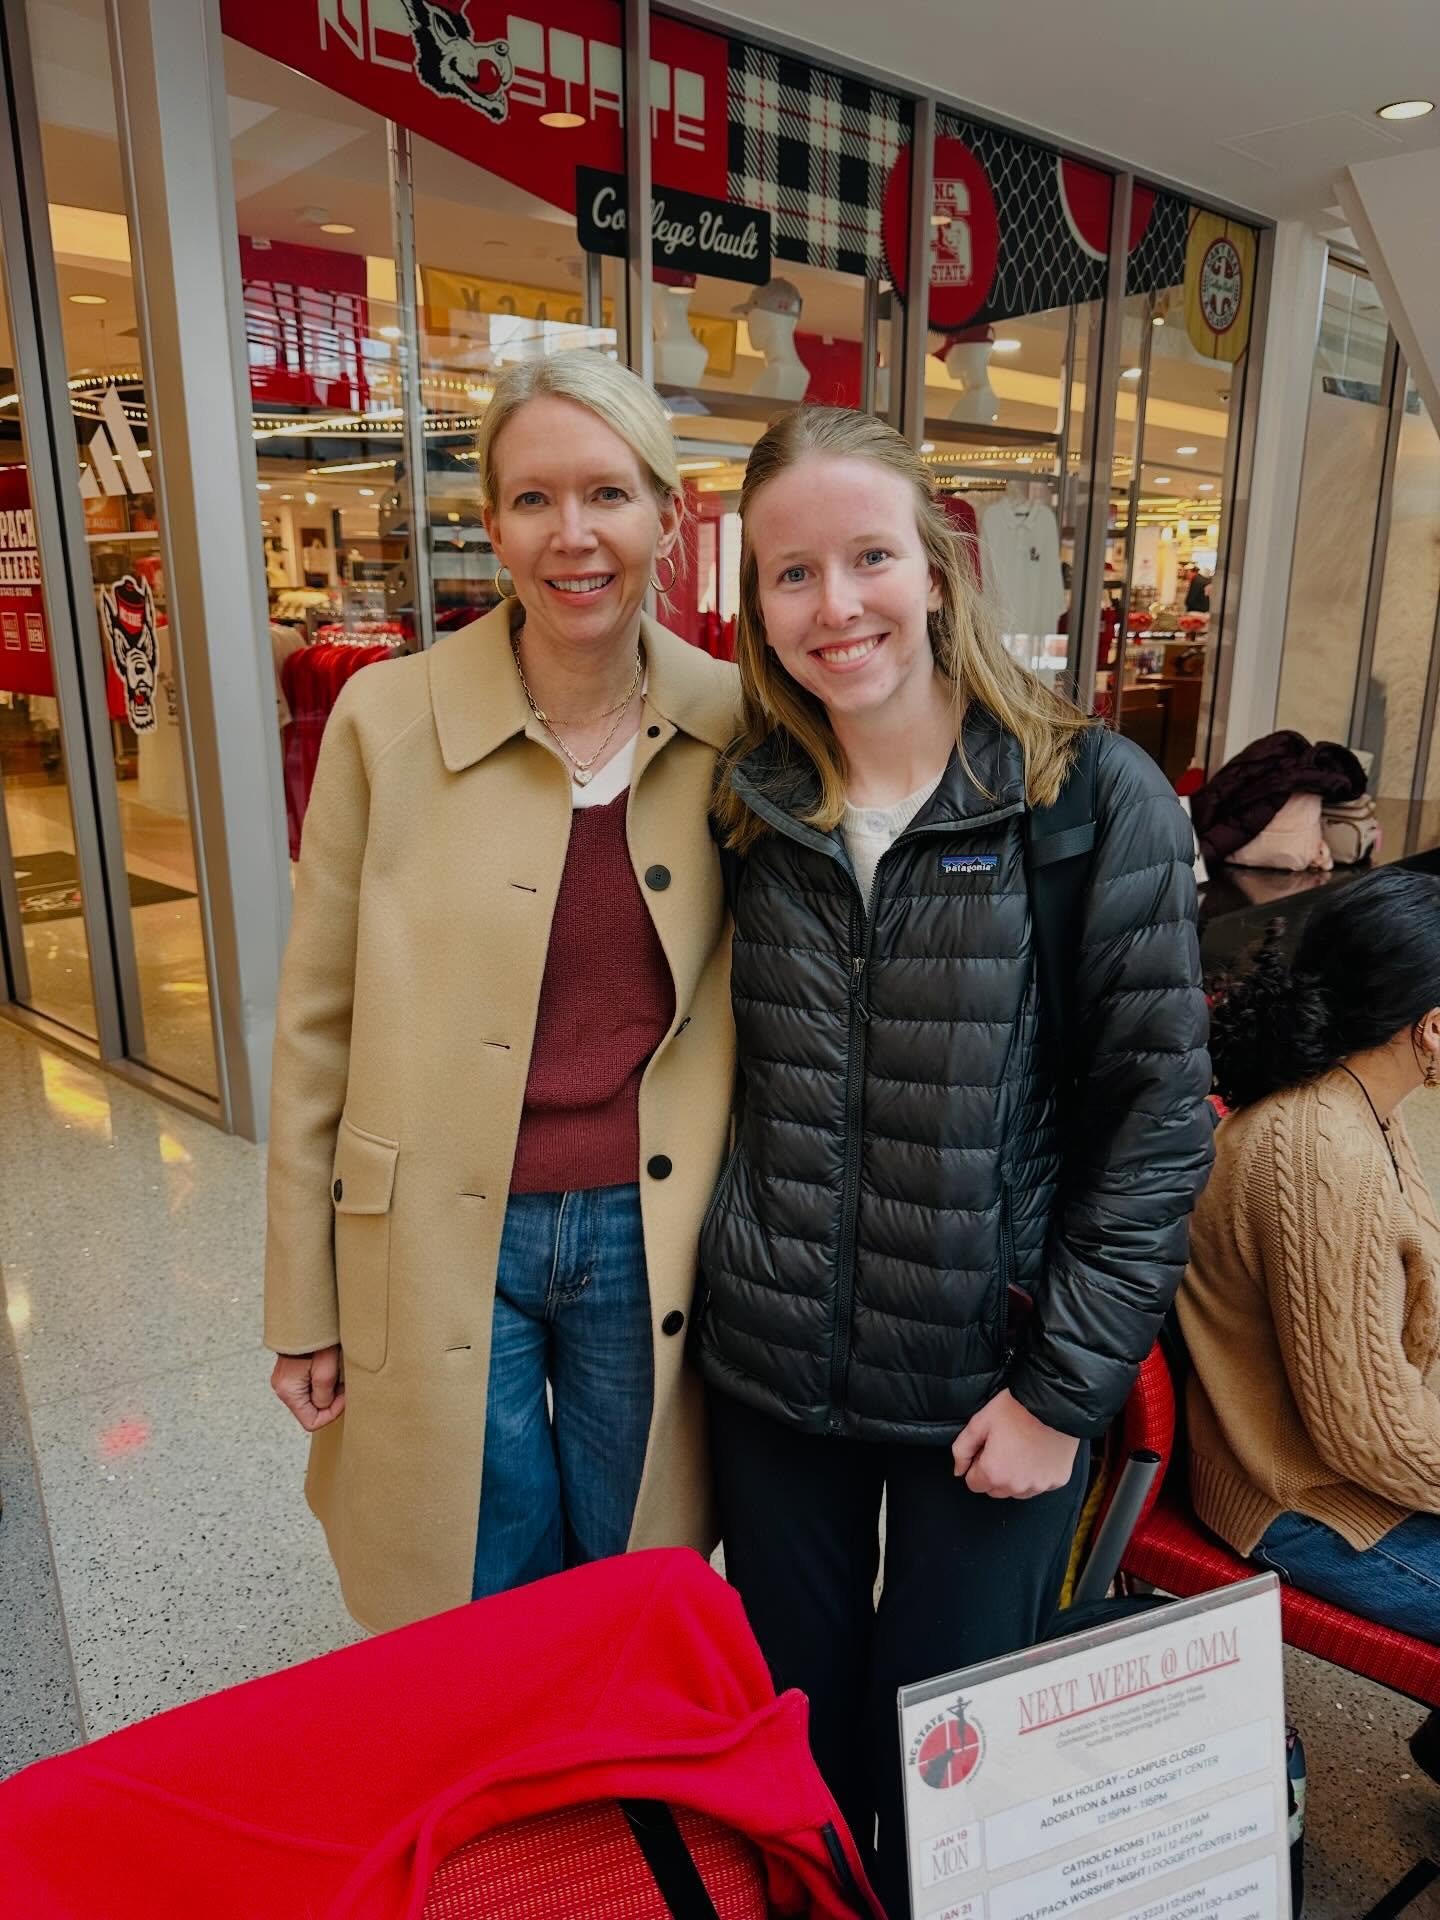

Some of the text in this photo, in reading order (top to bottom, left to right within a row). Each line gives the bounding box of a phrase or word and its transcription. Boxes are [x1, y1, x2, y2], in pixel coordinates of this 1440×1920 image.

[507, 15, 705, 152] STATE
[592, 186, 760, 261] Colege Vault
[931, 264, 966, 281] STATE
[945, 864, 992, 874] patagonia
[1018, 1627, 1239, 1729] NEXT WEEK @ CMM
[914, 1712, 944, 1746] STATE
[1040, 1801, 1099, 1829] ADORATION
[1109, 1785, 1137, 1801] MASS
[1184, 1755, 1220, 1776] CENTER
[1052, 1794, 1073, 1806] MLK
[1075, 1775, 1118, 1798] HOLIDAY
[1127, 1759, 1168, 1779] CAMPUS
[1169, 1743, 1207, 1764] CLOSED
[932, 1835, 954, 1851] JAN
[932, 1841, 968, 1880] MON
[1062, 1849, 1112, 1876] CATHOLIC
[1113, 1837, 1145, 1855] MOMS
[1151, 1823, 1183, 1842] TALLEY
[1070, 1879, 1115, 1903] WORSHIP
[1116, 1868, 1146, 1884] NIGHT
[1198, 1833, 1232, 1853] CENTER
[1240, 1823, 1258, 1838] 5PM
[1070, 1871, 1098, 1888] MASS
[1104, 1857, 1137, 1876] TALLEY
[961, 1903, 972, 1914] 21
